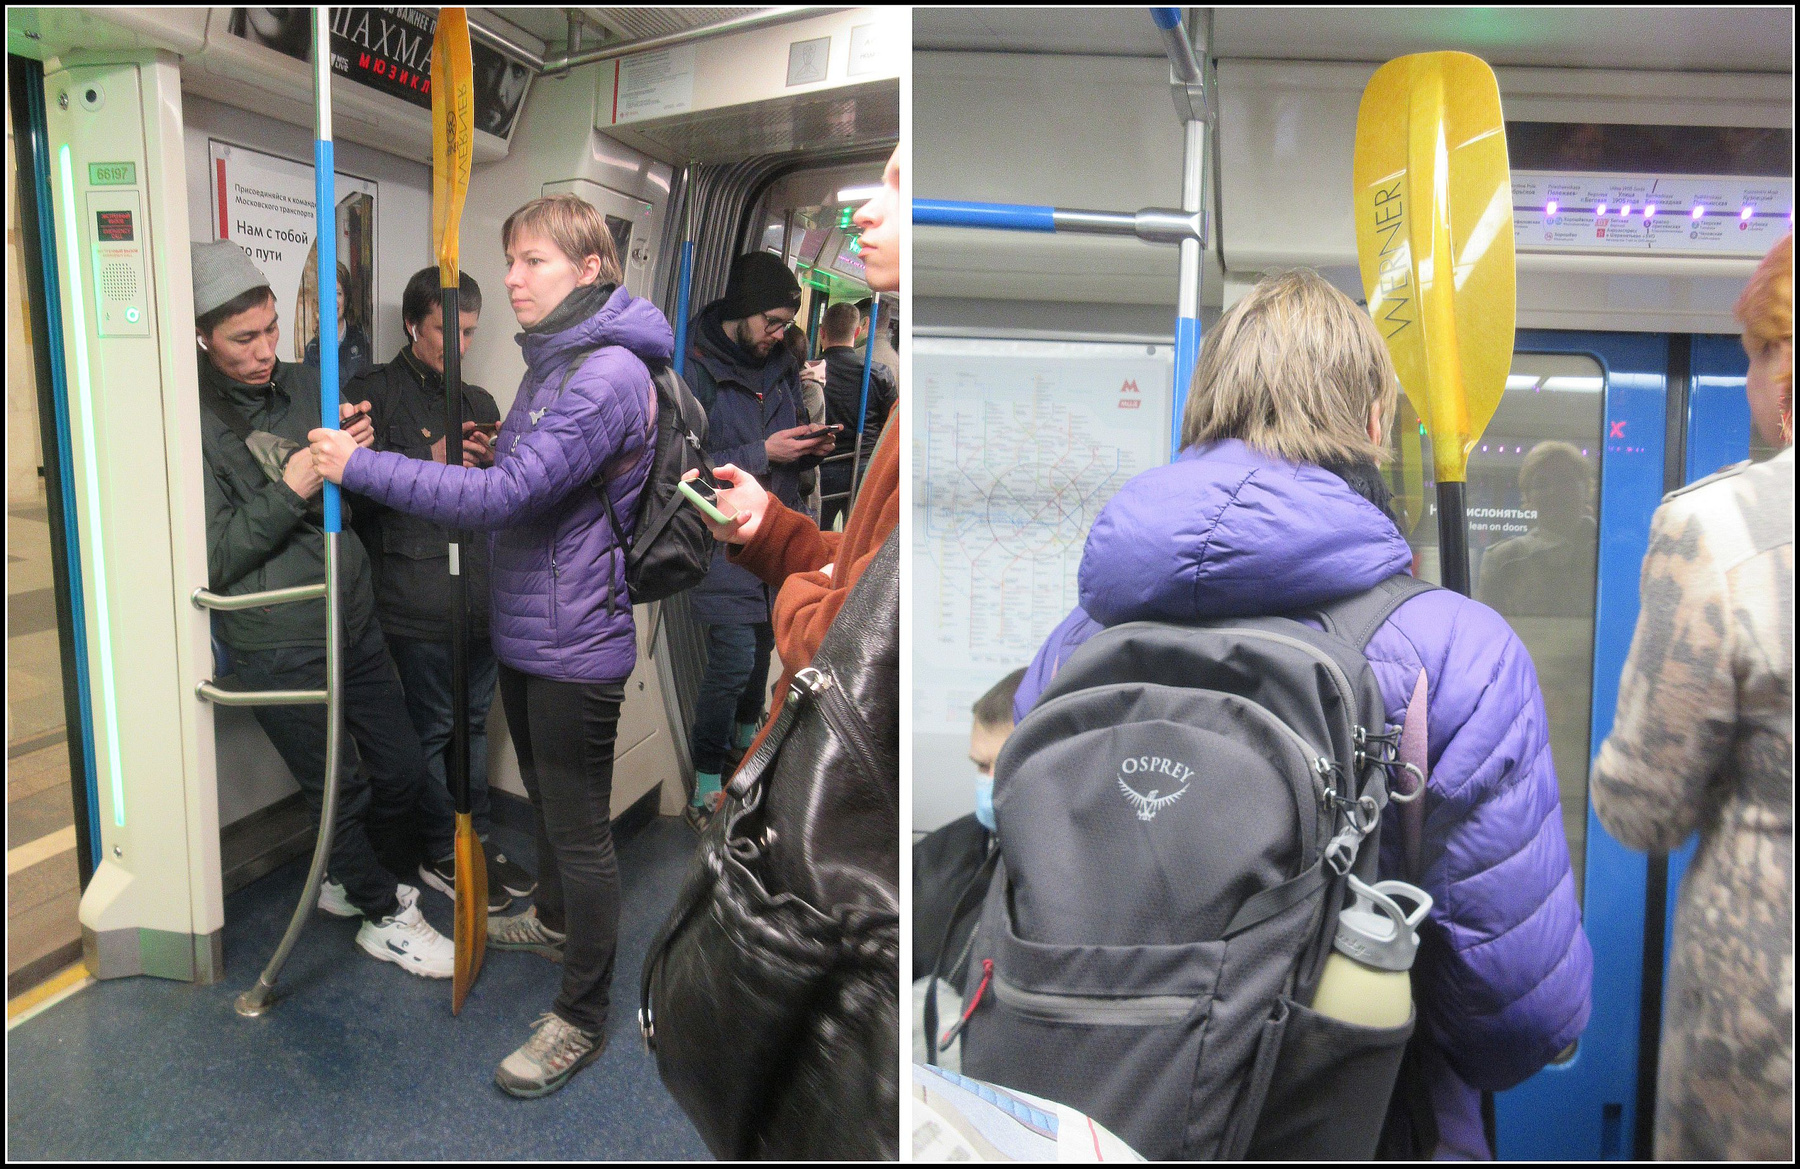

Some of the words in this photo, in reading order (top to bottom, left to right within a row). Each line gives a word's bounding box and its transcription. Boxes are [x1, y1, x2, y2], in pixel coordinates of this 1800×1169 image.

[359, 51, 431, 94] МЮЗИКЛ
[97, 167, 129, 180] 66197
[234, 183, 287, 203] Присоединяйся
[235, 195, 279, 212] Московского
[279, 205, 314, 219] транспорта
[236, 219, 264, 238] Нам
[266, 228, 273, 239] с
[275, 229, 309, 245] тобой
[255, 246, 282, 263] пути
[1374, 181, 1412, 339] WERNER
[1466, 507, 1538, 519] ислоняться
[1468, 521, 1488, 531] lean
[1489, 523, 1501, 531] on
[1502, 522, 1528, 532] doors
[1122, 755, 1195, 783] OSPREY
